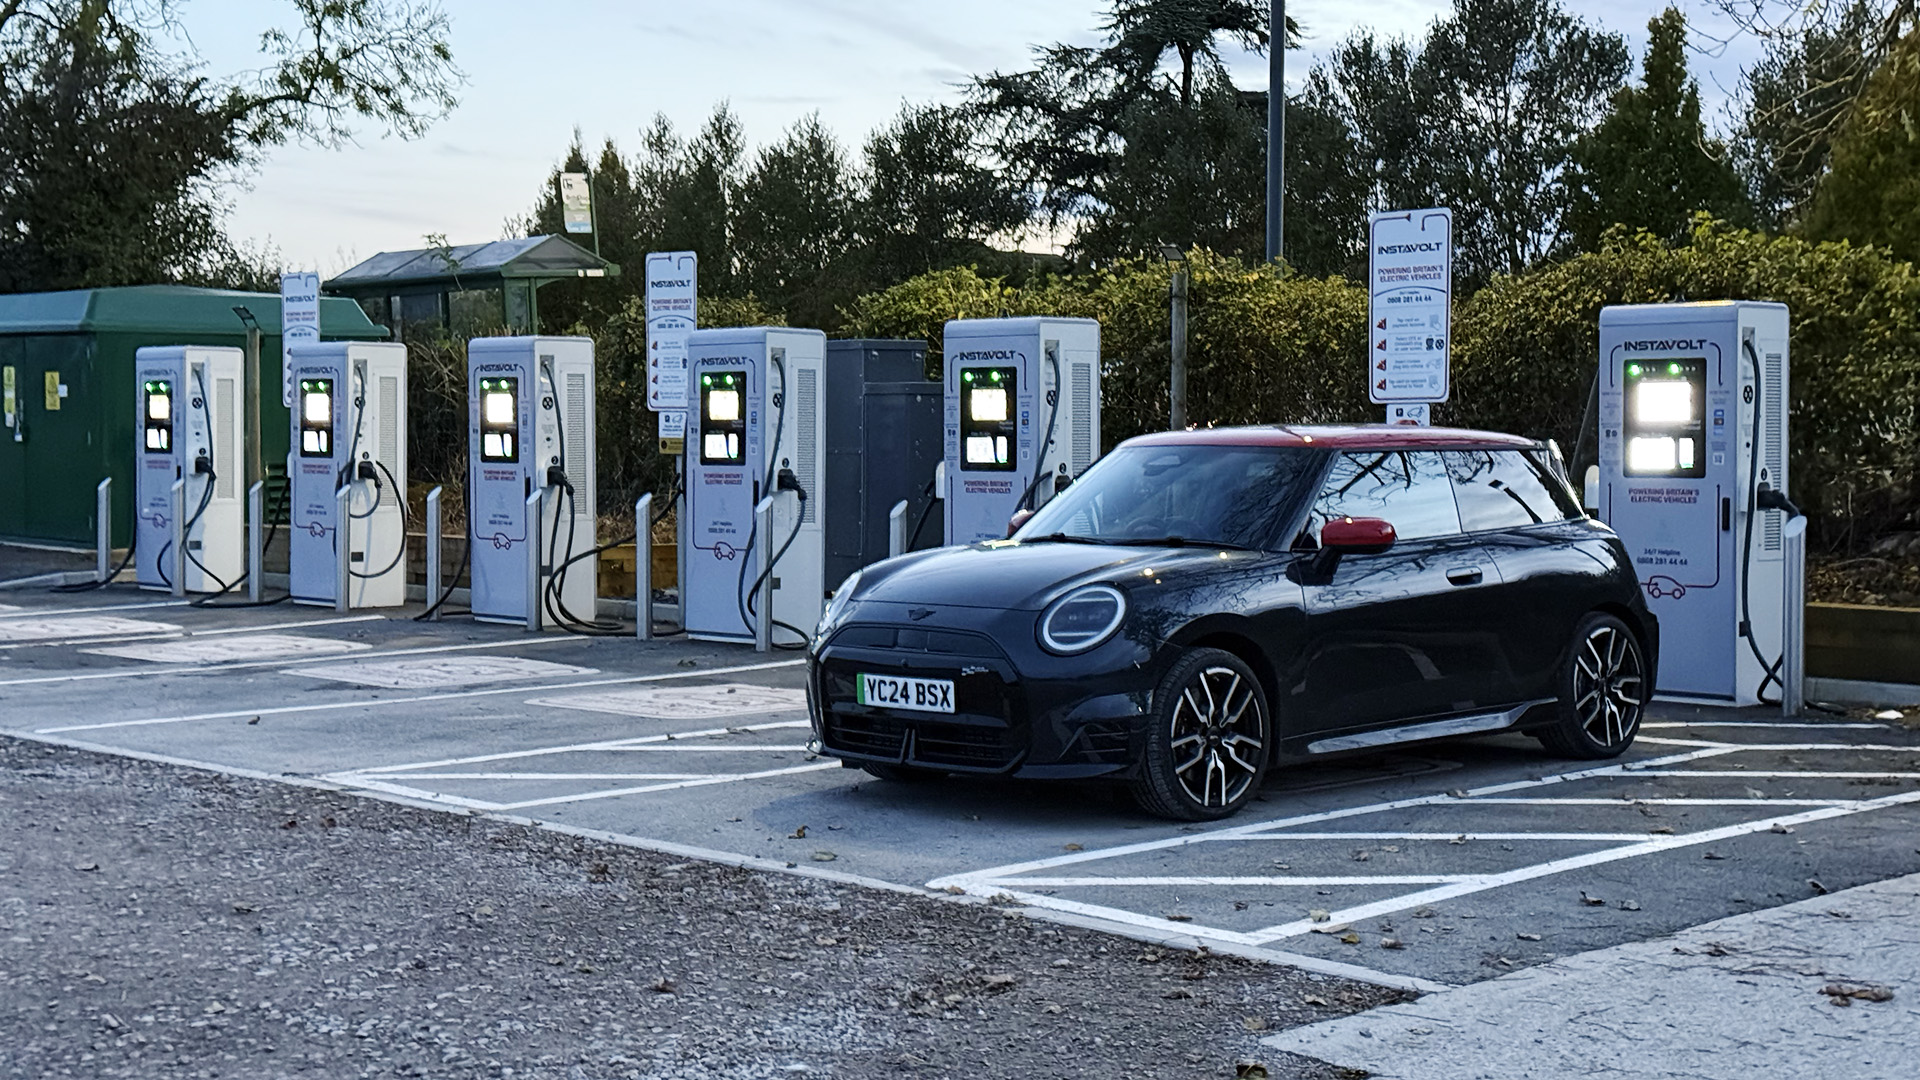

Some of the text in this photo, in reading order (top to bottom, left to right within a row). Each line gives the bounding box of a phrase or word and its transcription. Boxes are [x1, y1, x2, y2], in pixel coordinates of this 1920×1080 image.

[1378, 242, 1443, 255] INSTAVOLT
[1378, 265, 1443, 275] POWERING BRITAIN'S
[1411, 273, 1441, 281] VEHICLES
[651, 280, 692, 288] INSTAVOLT
[1624, 339, 1707, 352] INSTAVOLT
[959, 350, 1016, 361] INSTAVOLT
[701, 356, 747, 366] INSTAVOLT
[480, 364, 518, 372] INSTAVOLT
[1666, 488, 1700, 496] BRITAIN'S
[1631, 496, 1697, 504] ELECTRIC VEHICLES
[867, 678, 951, 708] YC24 BSX
